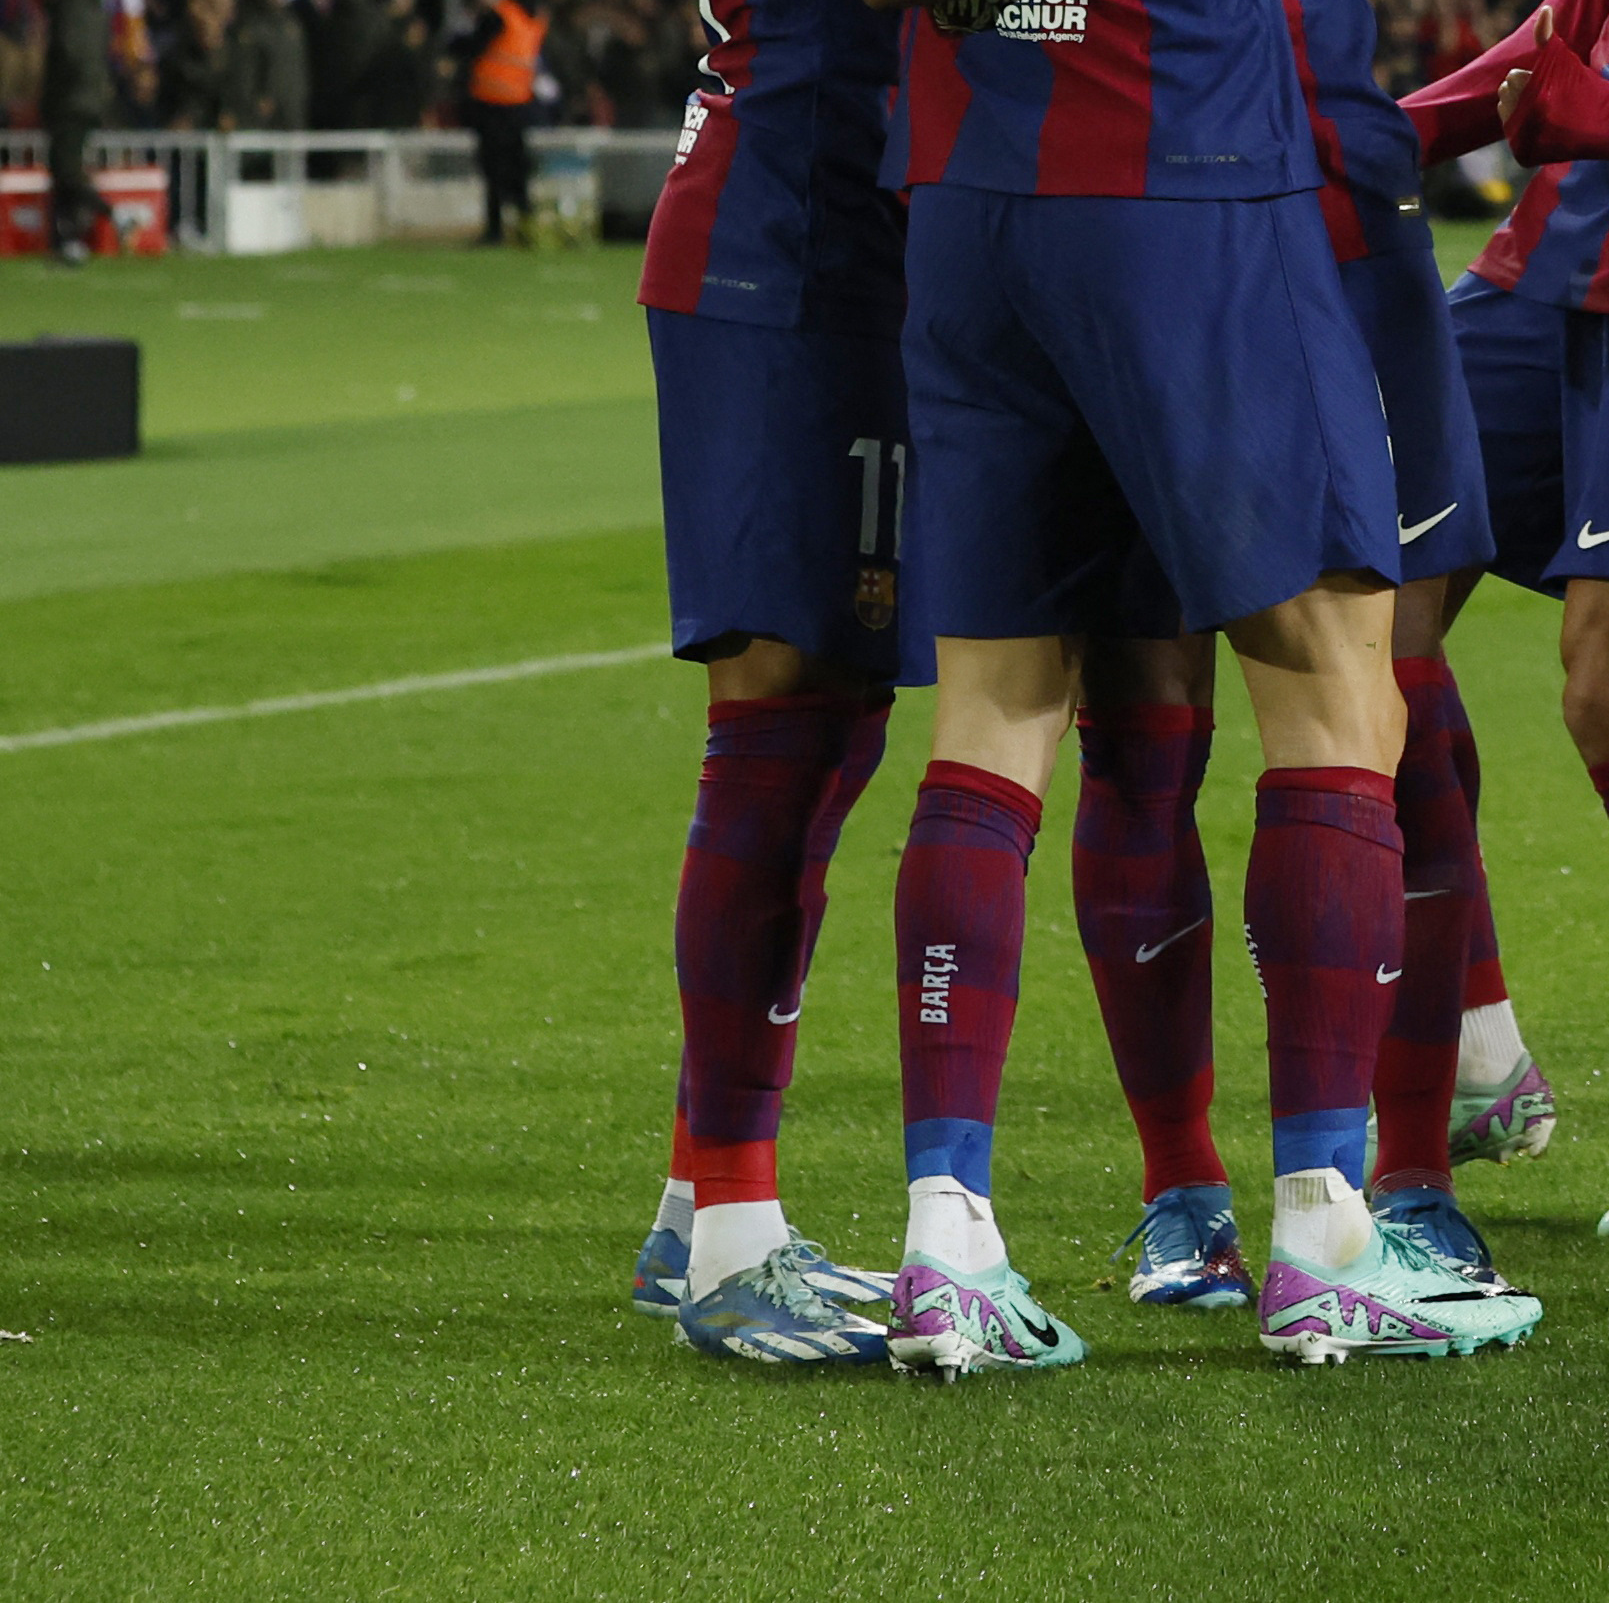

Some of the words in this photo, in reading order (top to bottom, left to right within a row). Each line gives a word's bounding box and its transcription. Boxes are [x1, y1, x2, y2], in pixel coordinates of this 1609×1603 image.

[995, 4, 1088, 31] ACNUR
[1048, 30, 1085, 43] Agency
[848, 437, 906, 560] 11
[920, 944, 960, 1024] BARÇA
